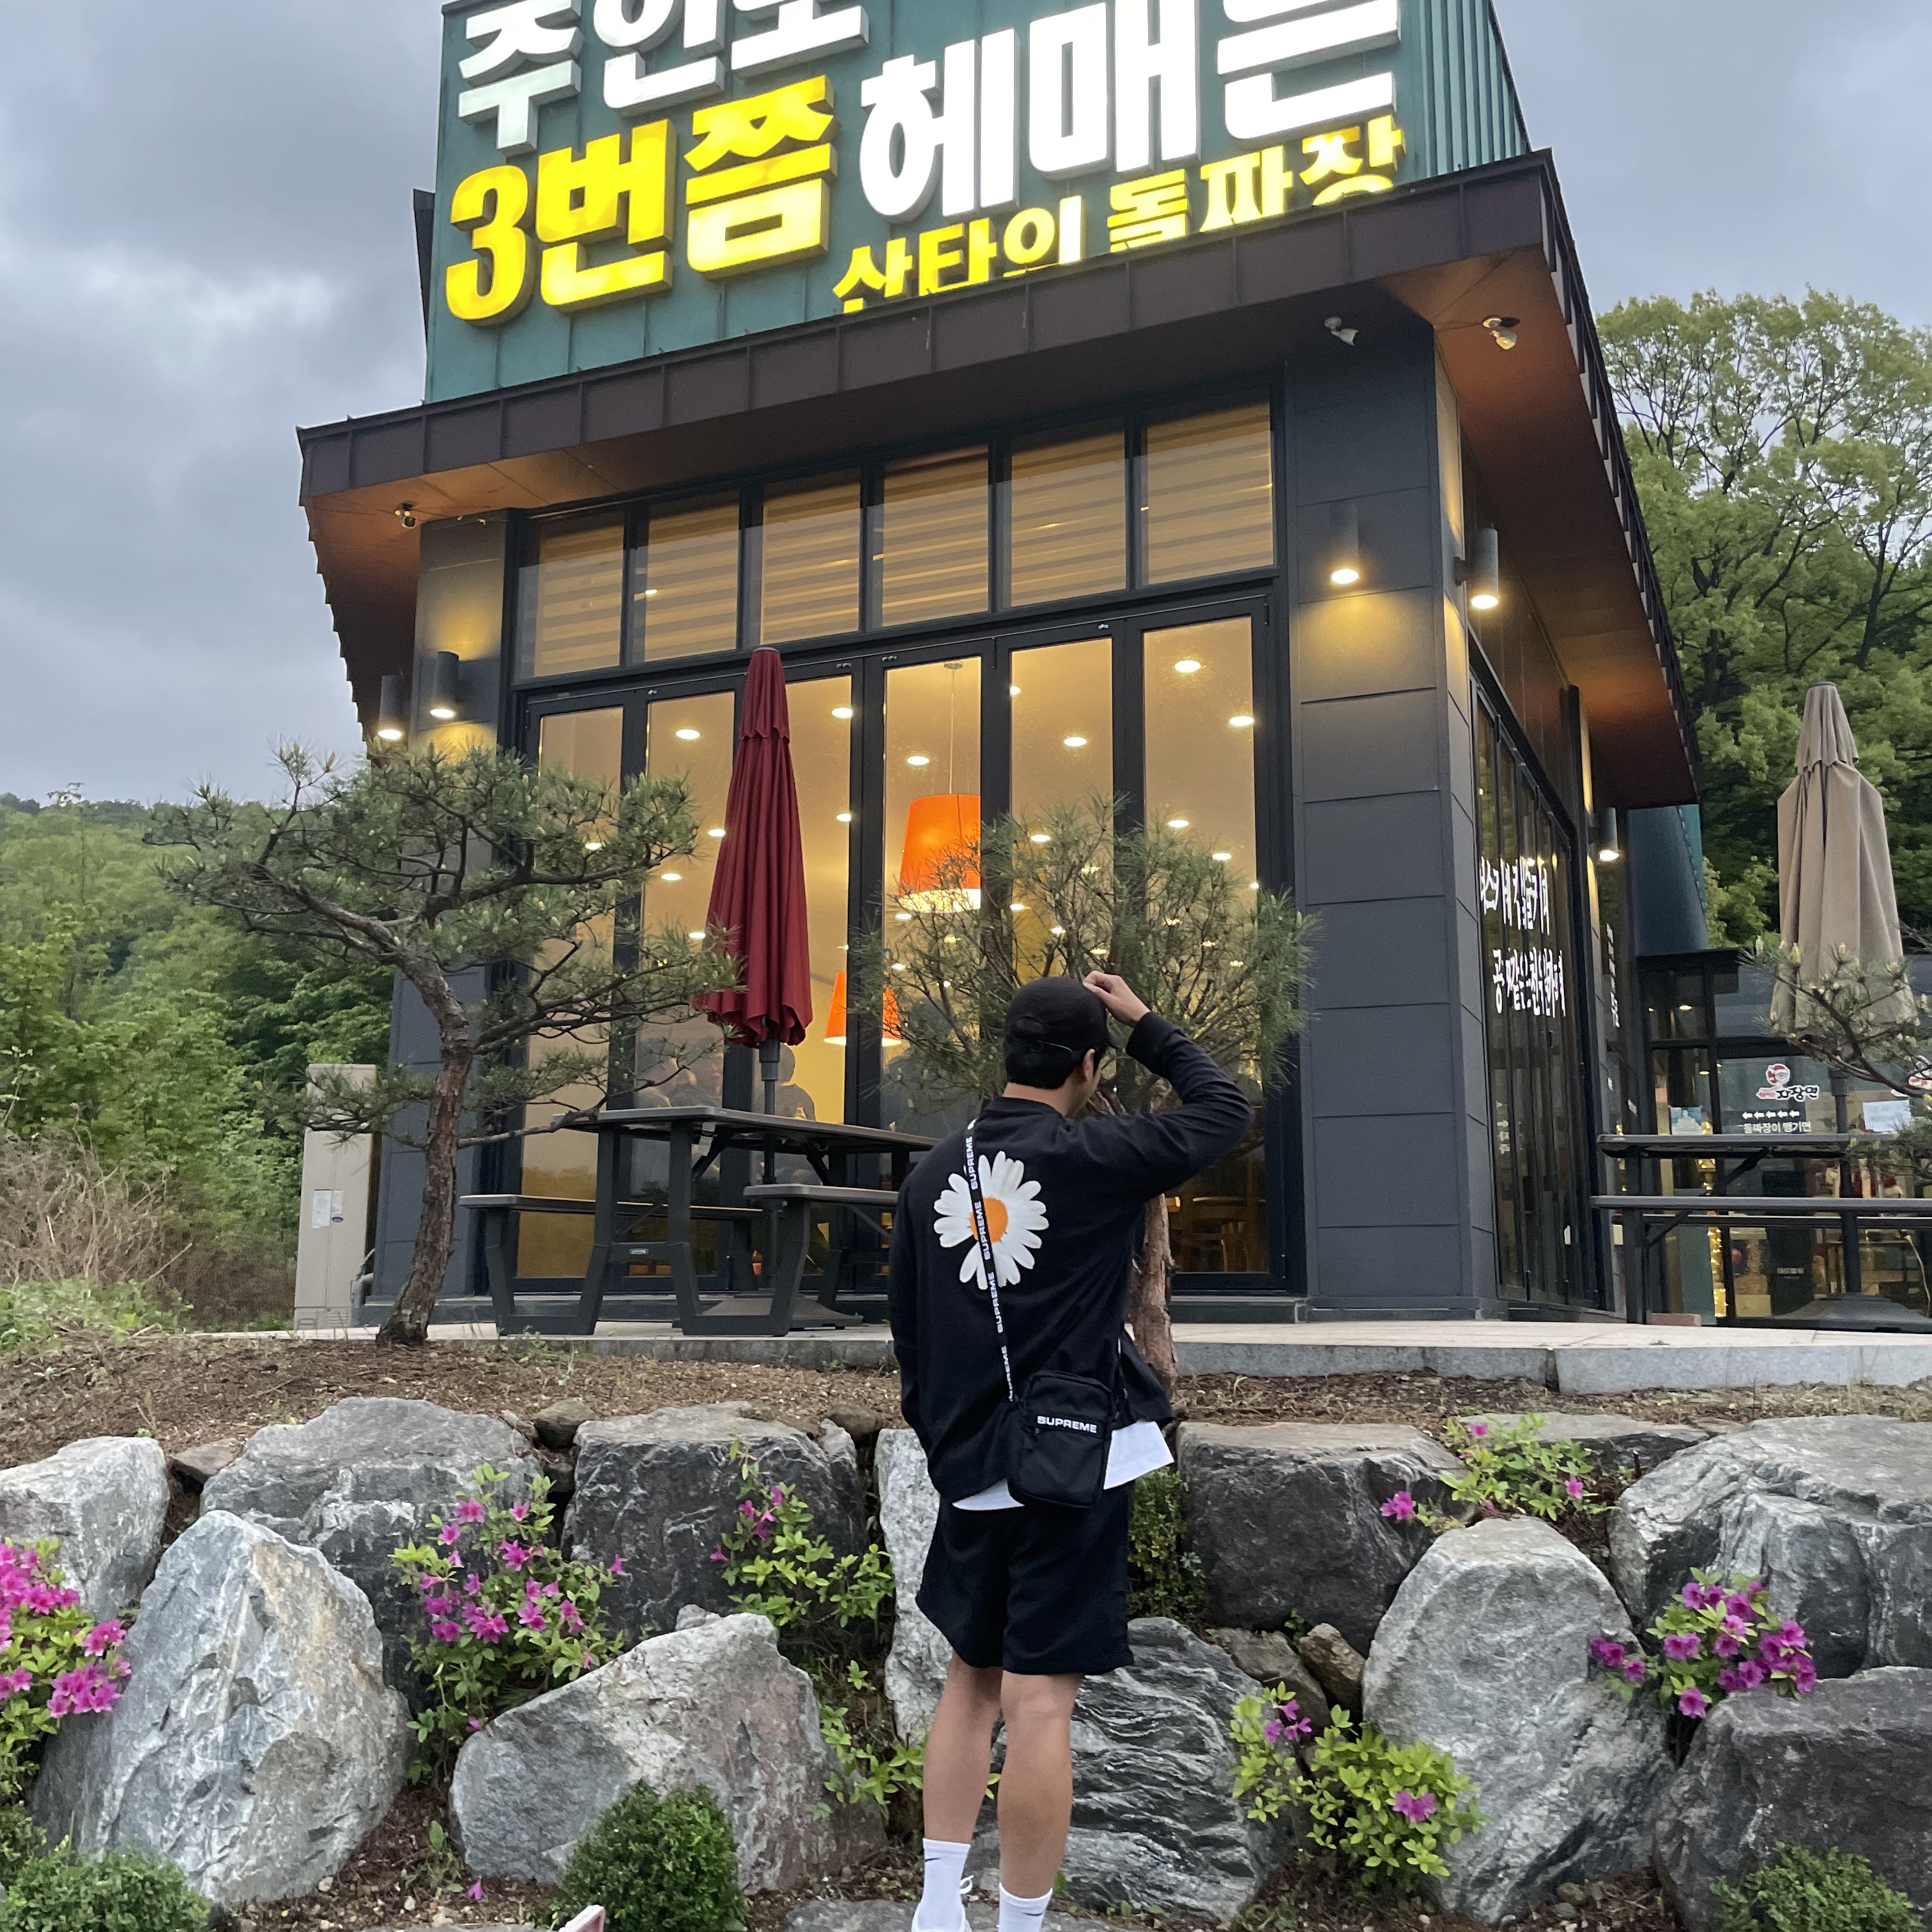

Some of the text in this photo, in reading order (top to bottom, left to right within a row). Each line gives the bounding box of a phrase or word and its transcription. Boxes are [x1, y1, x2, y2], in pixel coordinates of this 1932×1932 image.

[446, 0, 1401, 323] 3번쯤 헤매는
[832, 115, 1404, 313] 산타의 돌짜장
[965, 1136, 979, 1190] SUPREME
[974, 1201, 991, 1261] SUPREME
[987, 1271, 1004, 1333] SUPREME
[1001, 1346, 1013, 1402] UPREME
[1037, 1415, 1097, 1433] SUPREME
